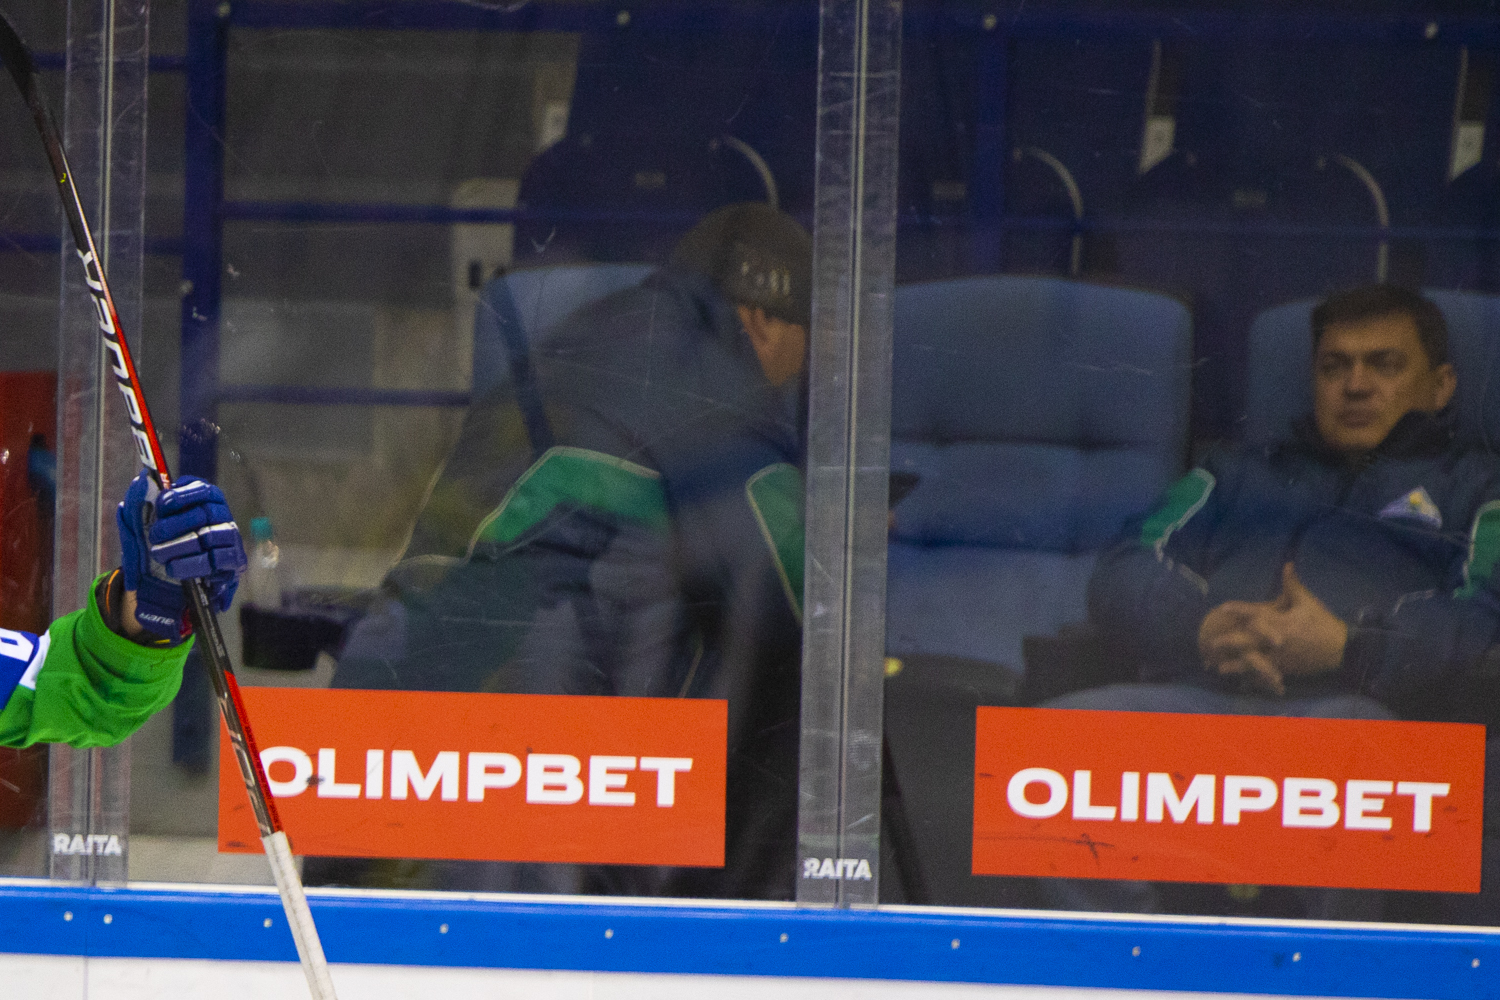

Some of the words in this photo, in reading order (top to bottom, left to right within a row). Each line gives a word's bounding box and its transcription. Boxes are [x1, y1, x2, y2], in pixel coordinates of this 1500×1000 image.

[259, 746, 693, 808] OLIMPBET
[1006, 767, 1451, 833] OLIMPBET
[53, 833, 122, 856] RAITA
[803, 857, 872, 881] RAITA
